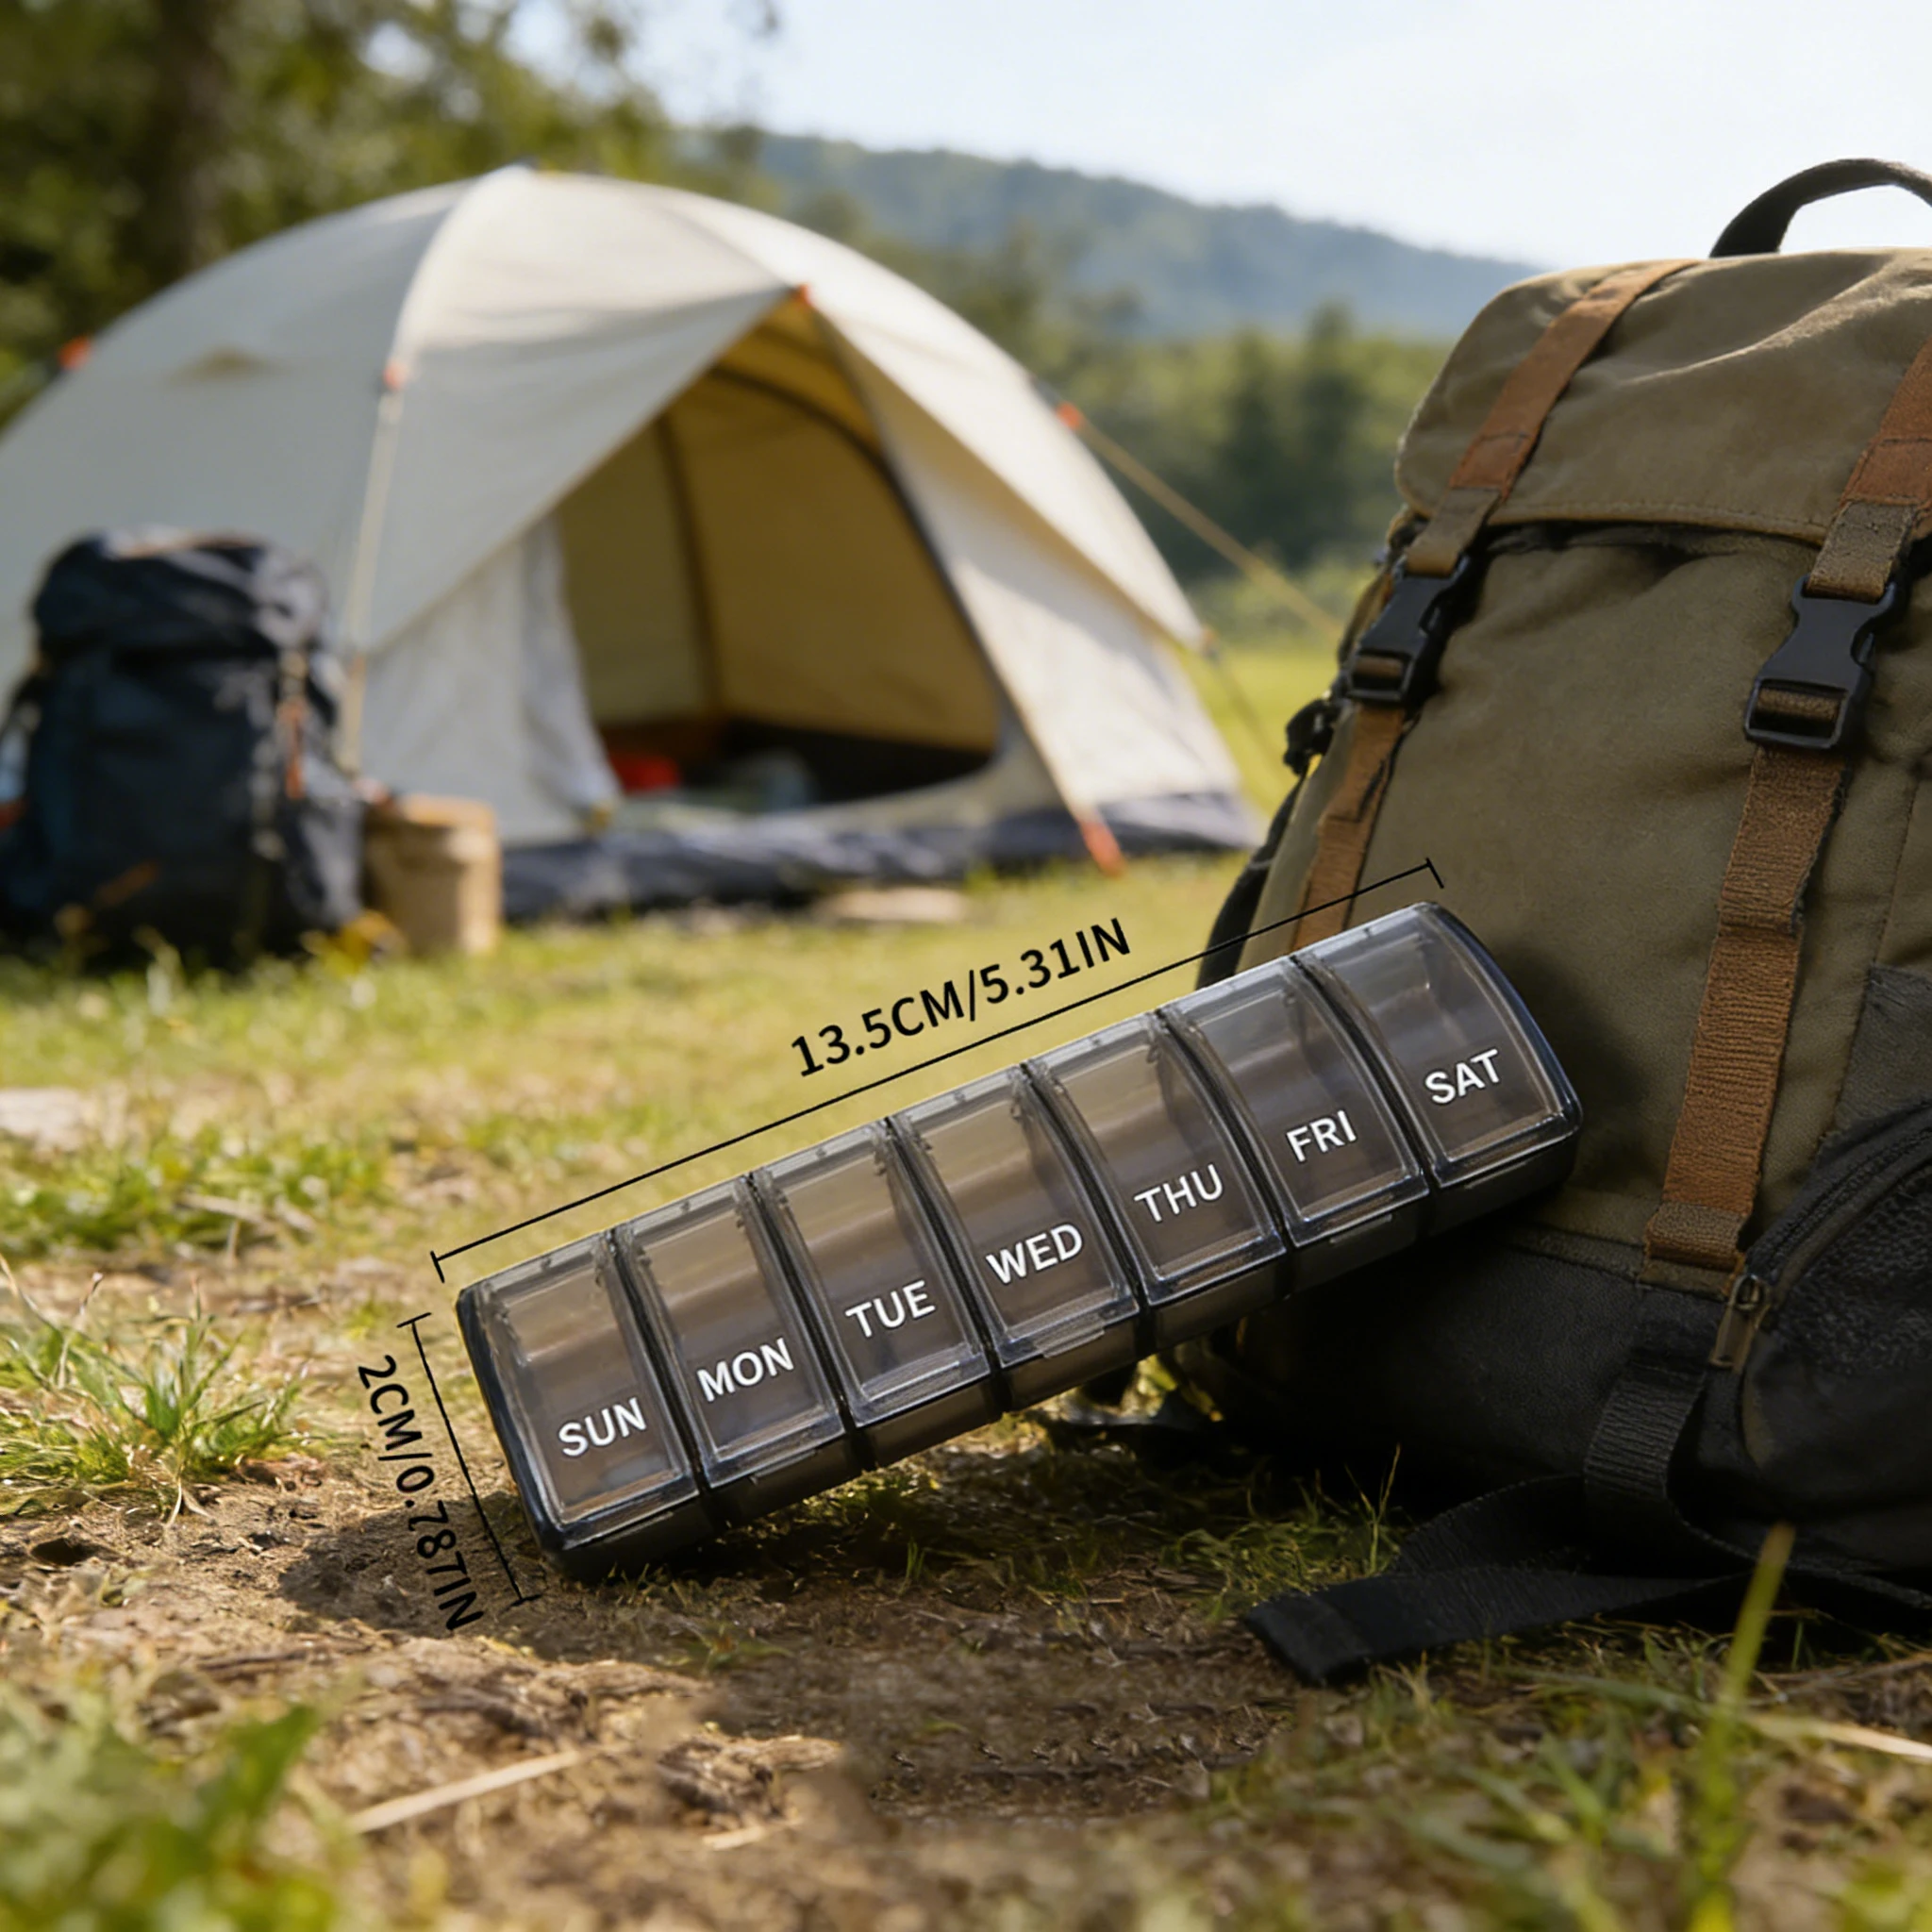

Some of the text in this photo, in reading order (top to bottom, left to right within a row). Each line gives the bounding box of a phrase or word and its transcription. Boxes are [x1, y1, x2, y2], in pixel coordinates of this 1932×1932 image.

[558, 1049, 1500, 1457] SUN MON TUE WED THU FRI SAT
